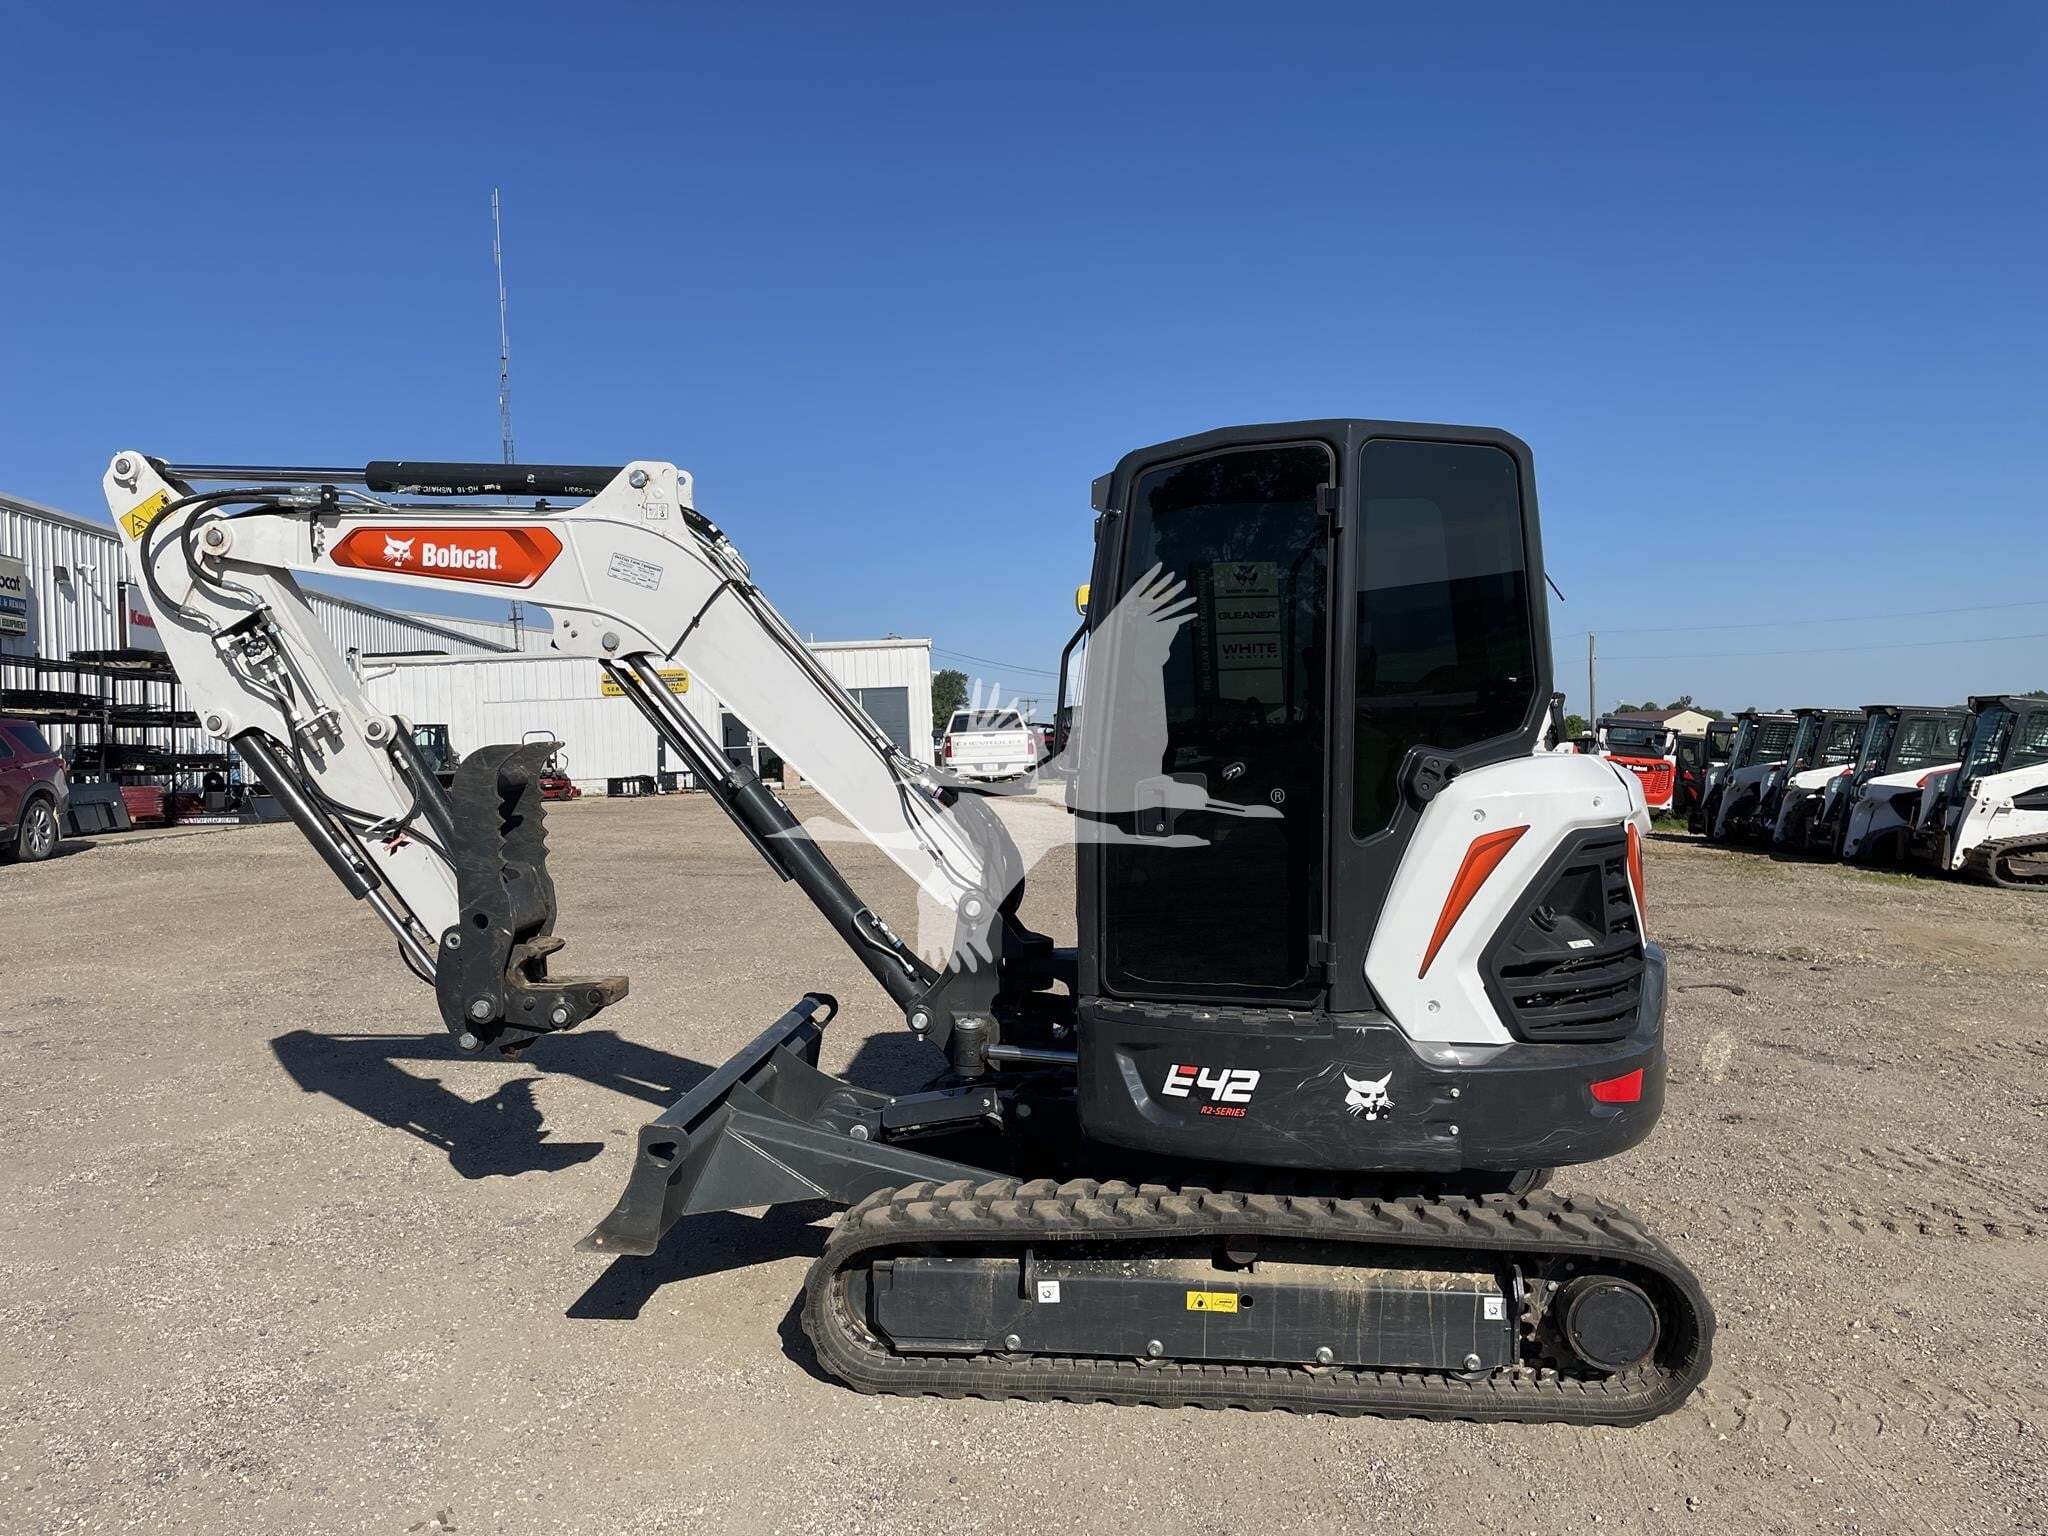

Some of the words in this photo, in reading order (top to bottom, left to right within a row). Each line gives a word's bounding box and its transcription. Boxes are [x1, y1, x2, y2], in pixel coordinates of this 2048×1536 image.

[422, 543, 498, 570] Bobcat
[1218, 611, 1277, 620] GLEANER
[1222, 643, 1278, 654] WHITE
[1162, 1064, 1260, 1103] E42
[1200, 1105, 1247, 1117] R2-SERIES
